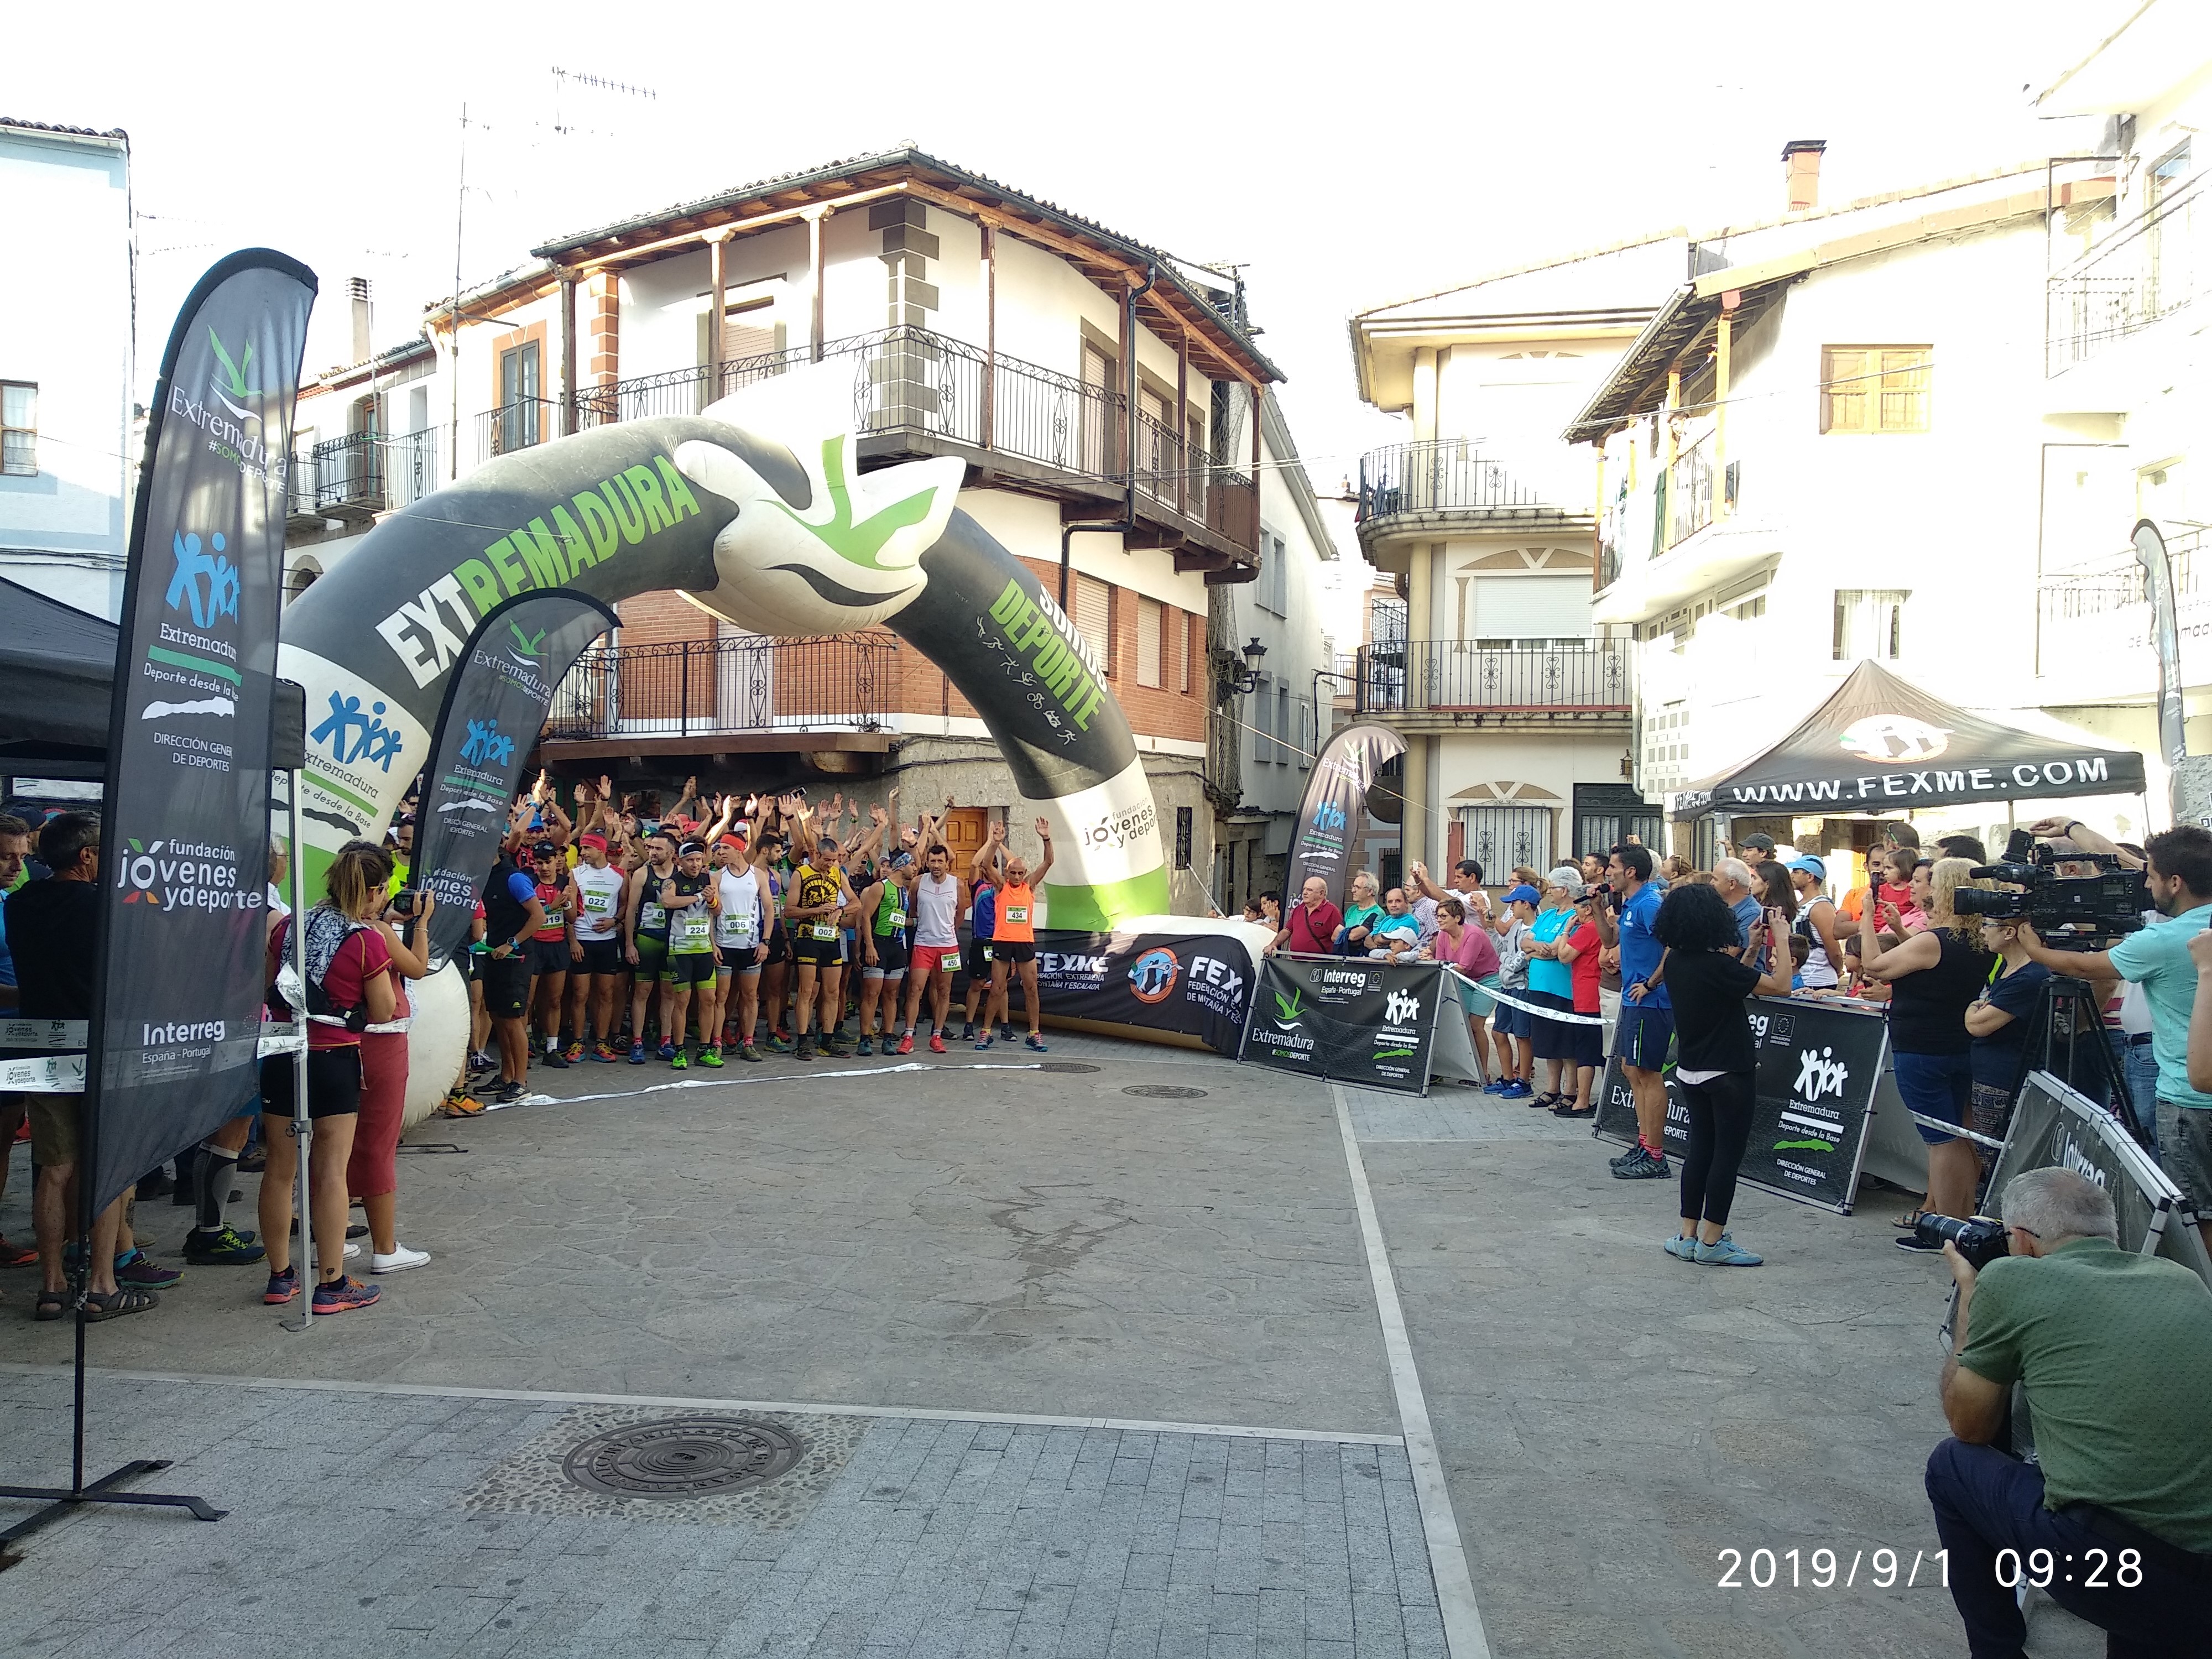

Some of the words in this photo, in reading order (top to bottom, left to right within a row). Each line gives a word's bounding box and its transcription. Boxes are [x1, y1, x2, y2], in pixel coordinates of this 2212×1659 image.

[374, 454, 701, 690] EXTREMADURA
[1039, 583, 1108, 693] SOMOS
[988, 577, 1107, 733] DEPORTE
[144, 662, 186, 682] Deporte
[189, 674, 221, 692] desde
[223, 681, 231, 696] la
[473, 649, 551, 698] Extremadura
[153, 731, 208, 752] DIRECCIÓN
[173, 752, 186, 764] DE
[188, 754, 230, 772] DEPORTES
[304, 750, 379, 799] xtremadura
[1733, 757, 2109, 804] WWW.FEXME.COM
[313, 791, 343, 811] desde
[344, 805, 353, 817] la
[355, 812, 372, 828] Base
[478, 792, 485, 800] la
[486, 795, 504, 806] Base
[462, 820, 488, 833] GENERAL
[1084, 805, 1153, 846] jóvenes
[169, 838, 236, 862] fundación
[1117, 834, 1125, 848] y
[117, 840, 237, 890] jóvenes
[588, 897, 606, 906] 022
[893, 915, 905, 924] 070
[818, 928, 833, 937] 002
[947, 959, 957, 967] 450
[1037, 980, 1063, 989] ONTAÑA
[1068, 982, 1100, 990] ESCALADA
[1065, 973, 1105, 982] EXTREMEÑA
[1323, 968, 1366, 988] Interreg
[1186, 992, 1197, 1001] DE
[1321, 985, 1337, 995] España
[1338, 986, 1363, 997] Portugal
[143, 1019, 226, 1046] Interreg
[1251, 1027, 1314, 1051] Extremadura
[1381, 1025, 1416, 1035] Extremadura
[142, 1050, 176, 1065] España
[182, 1044, 212, 1058] Portugal
[1788, 1099, 1840, 1120] Extremadura
[1777, 1120, 1801, 1133] Deporte
[1801, 1126, 1818, 1138] desde
[1818, 1130, 1825, 1139] la
[1825, 1133, 1840, 1143] Base
[1776, 1158, 1804, 1173] DIRECCIÓN
[1804, 1166, 1827, 1180] GENERAL
[1783, 1170, 1791, 1178] DE
[1791, 1172, 1817, 1186] DEPORTES
